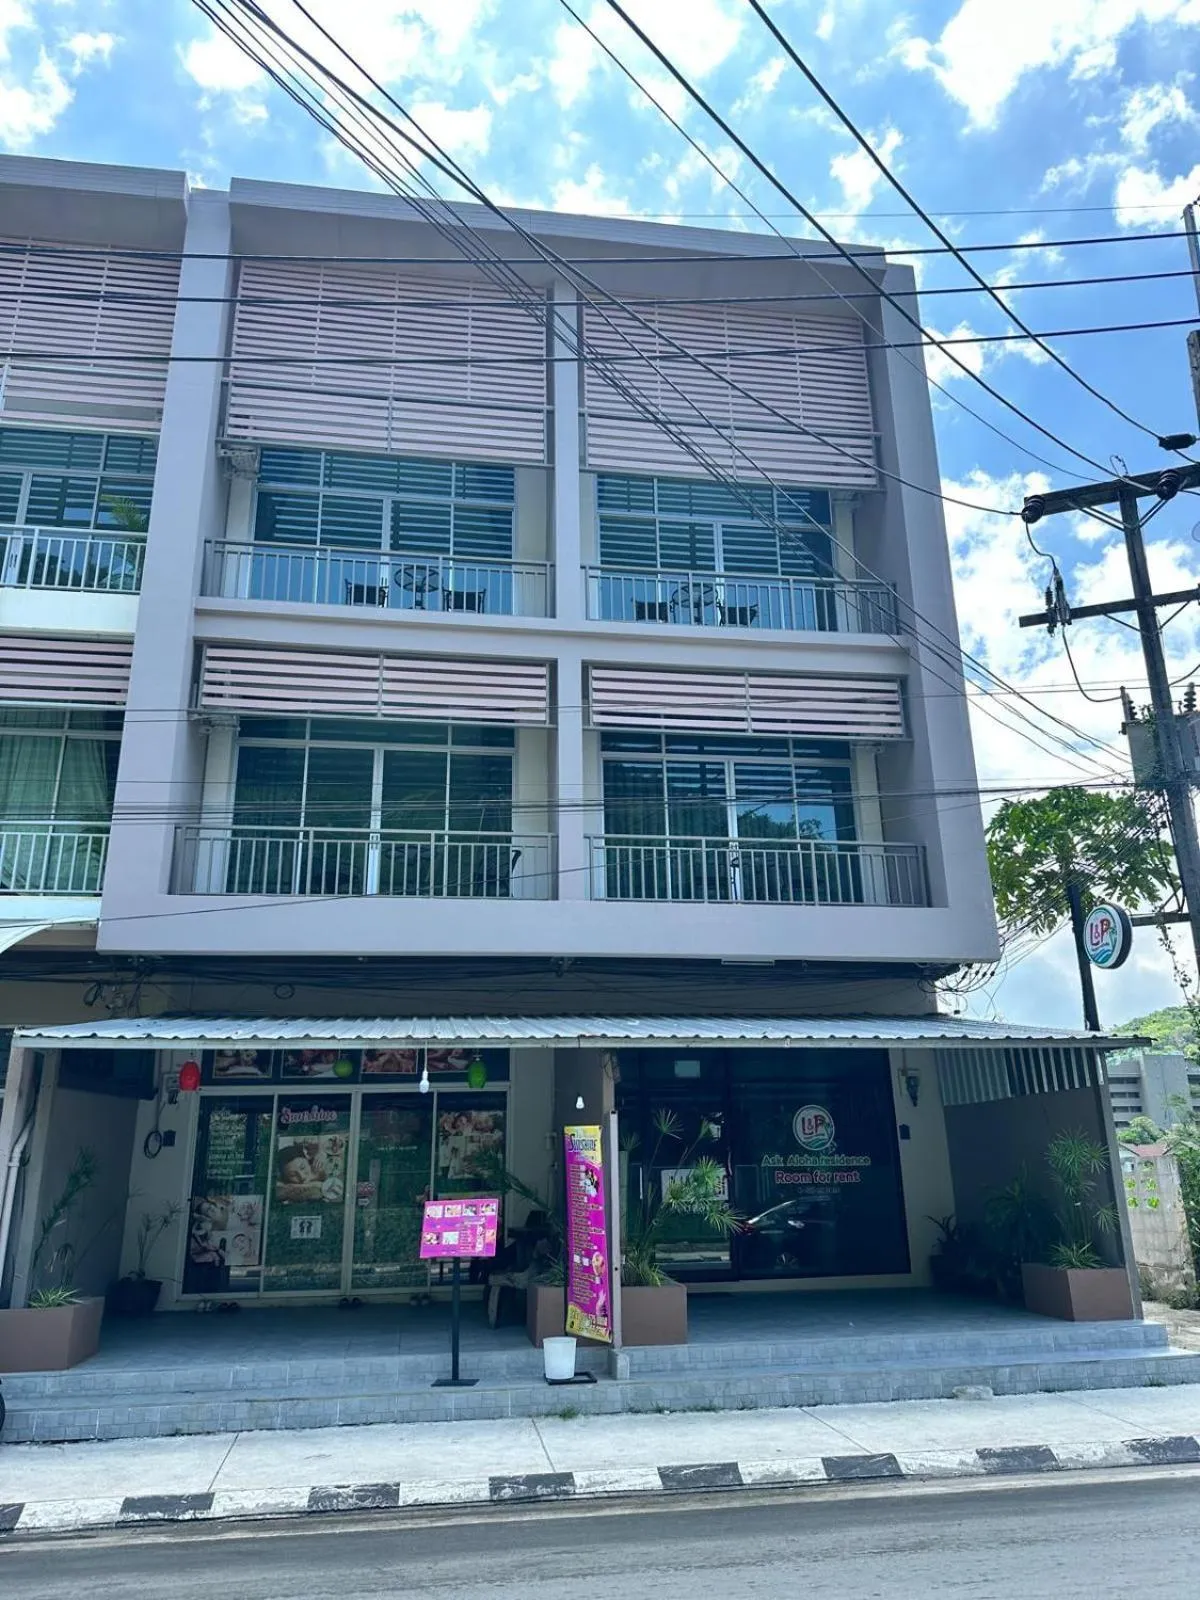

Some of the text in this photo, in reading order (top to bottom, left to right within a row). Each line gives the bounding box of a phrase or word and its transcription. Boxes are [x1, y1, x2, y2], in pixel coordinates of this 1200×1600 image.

[1090, 918, 1111, 946] L&P
[801, 1114, 826, 1136] L&P
[761, 1154, 871, 1167] Ask Aloha residence
[774, 1170, 861, 1184] Room for rent
